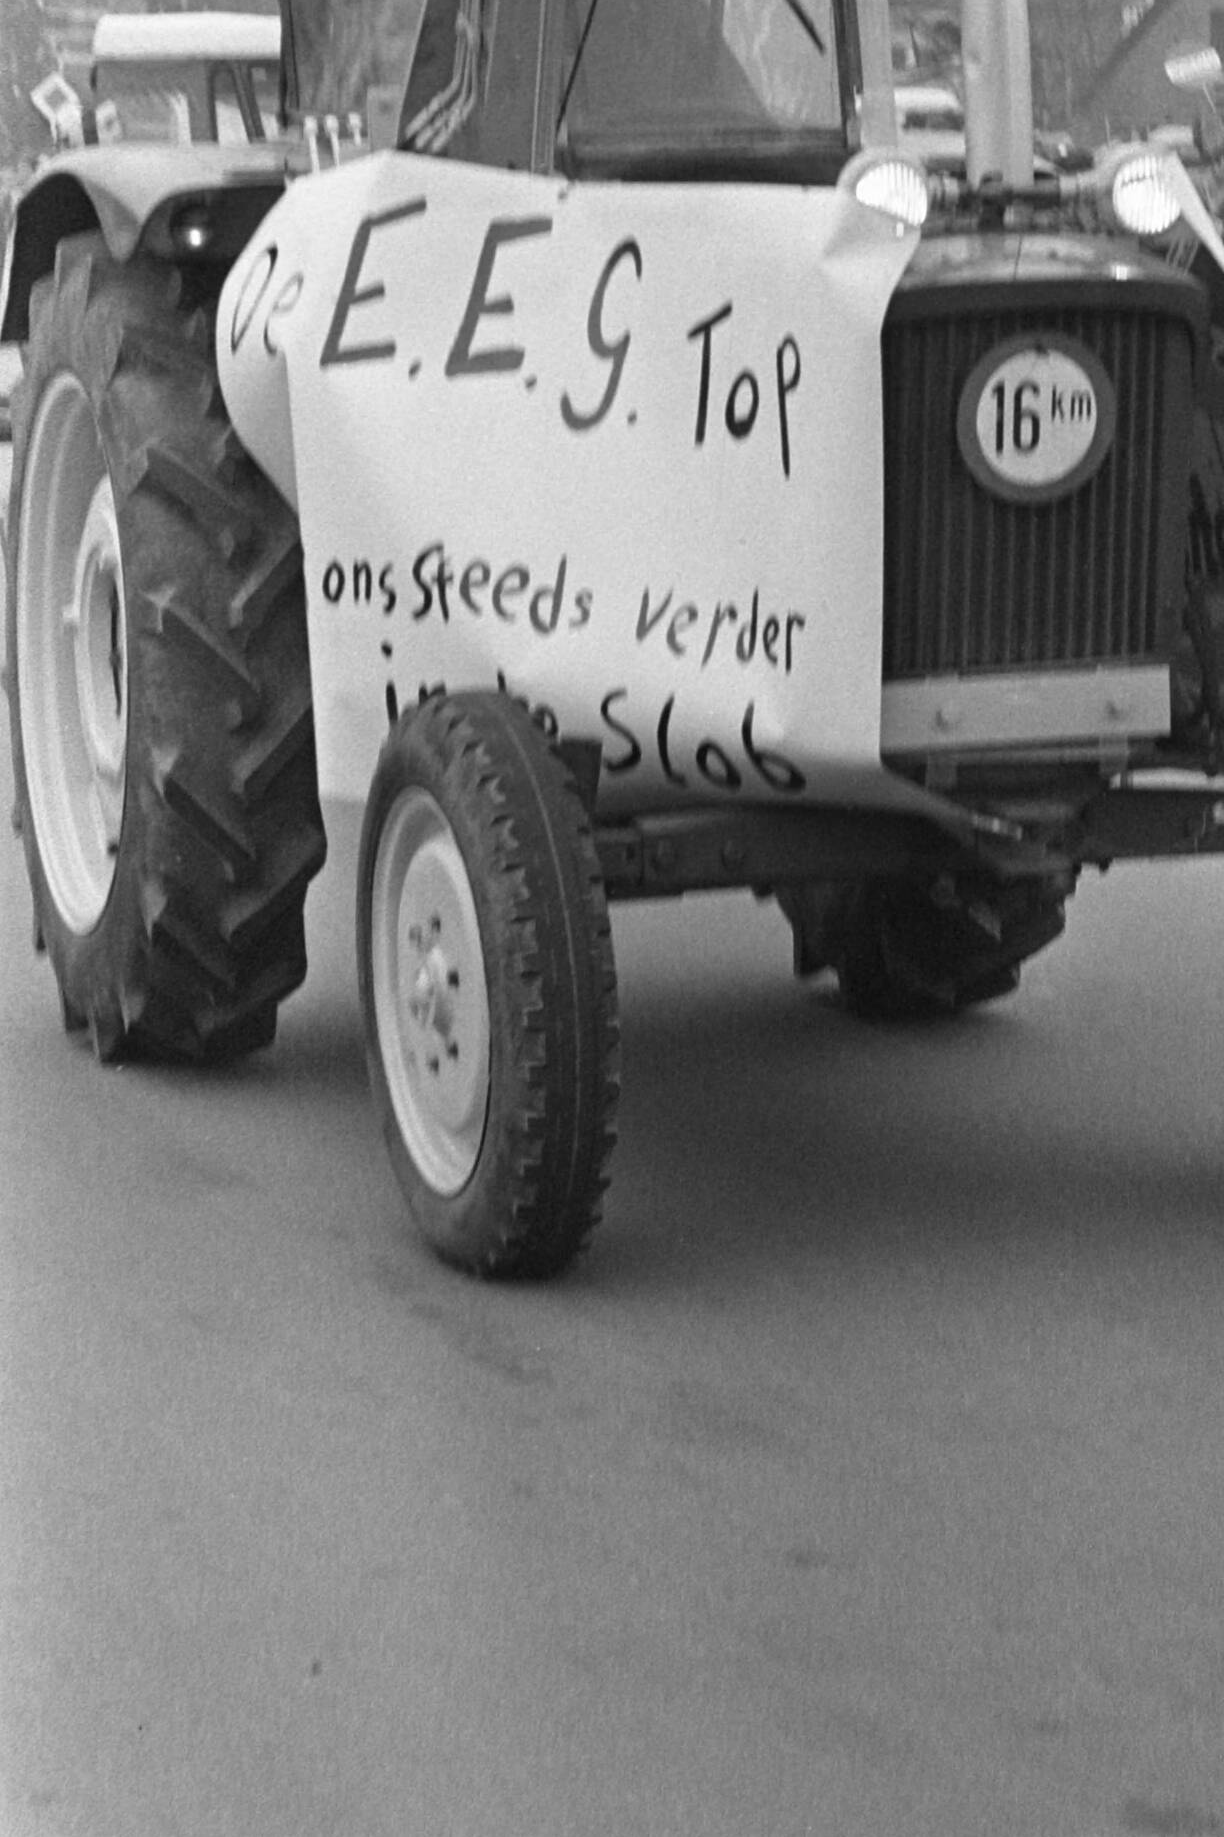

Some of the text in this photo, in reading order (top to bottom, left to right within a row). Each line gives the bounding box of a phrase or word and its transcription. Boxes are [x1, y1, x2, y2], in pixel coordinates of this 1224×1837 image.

[991, 379, 1093, 458] 16 km
[322, 558, 397, 614] ons
